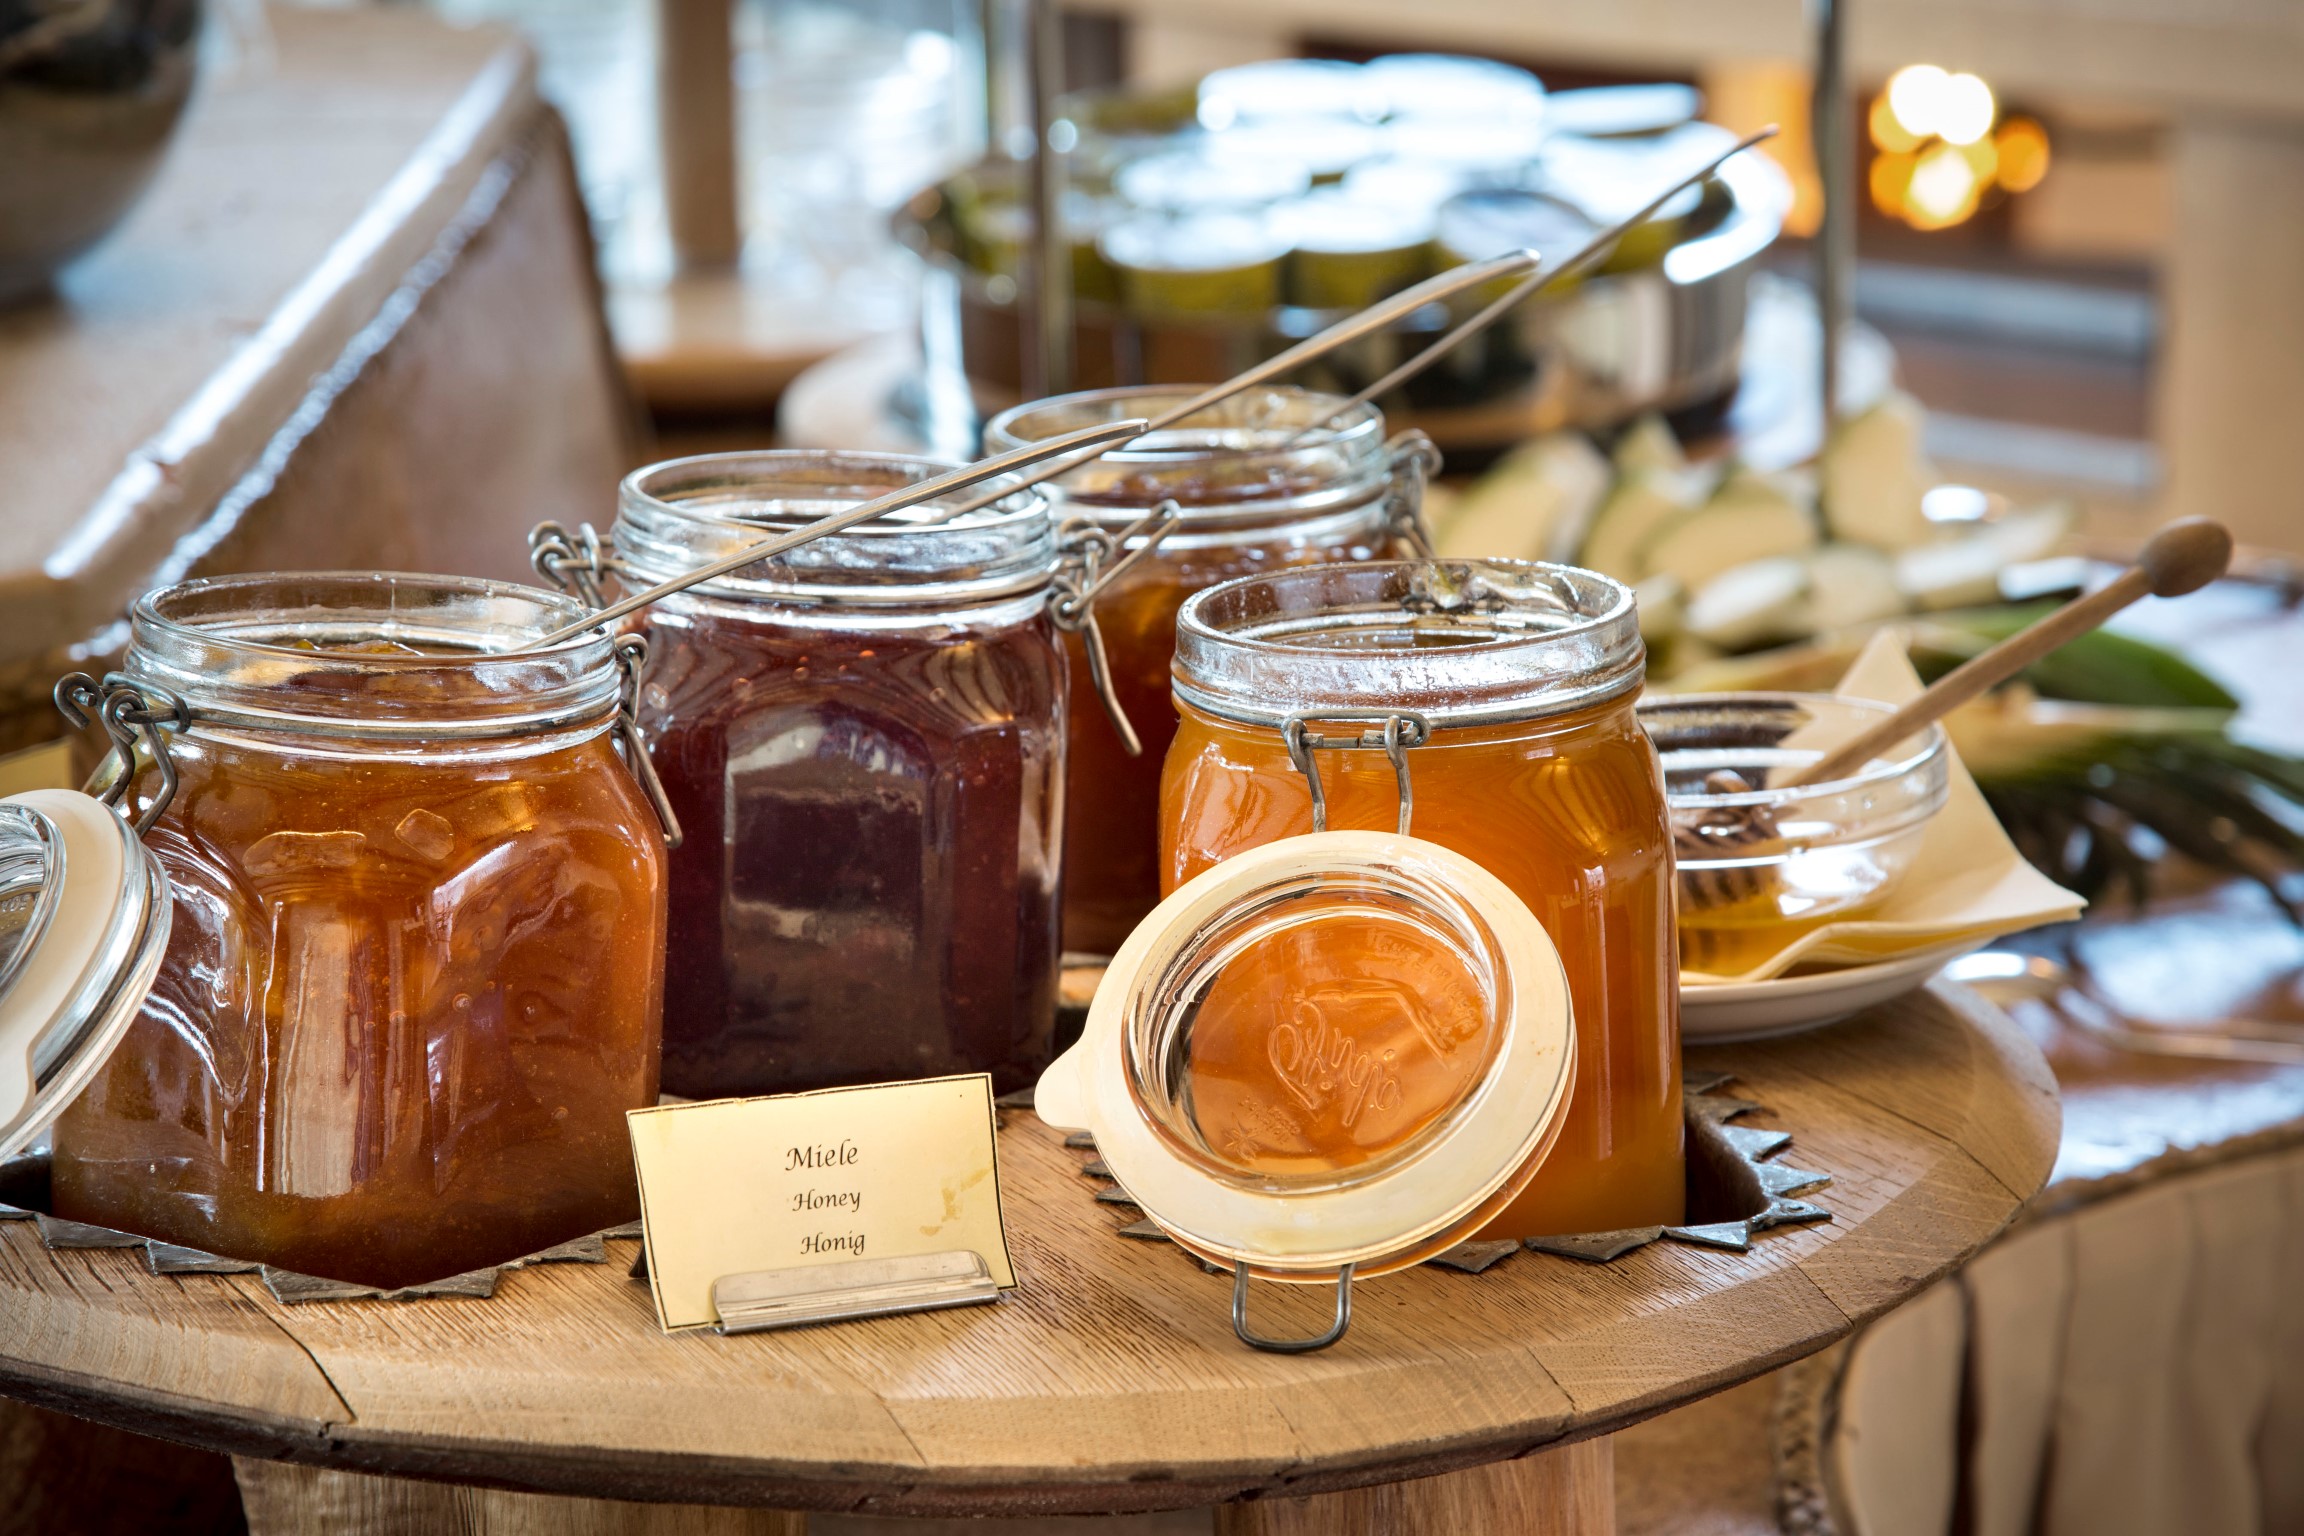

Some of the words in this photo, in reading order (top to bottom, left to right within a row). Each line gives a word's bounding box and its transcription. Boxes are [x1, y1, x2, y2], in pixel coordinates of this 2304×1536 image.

[785, 1138, 859, 1172] Miele
[792, 1187, 861, 1213] Honey
[800, 1230, 866, 1256] Honig
